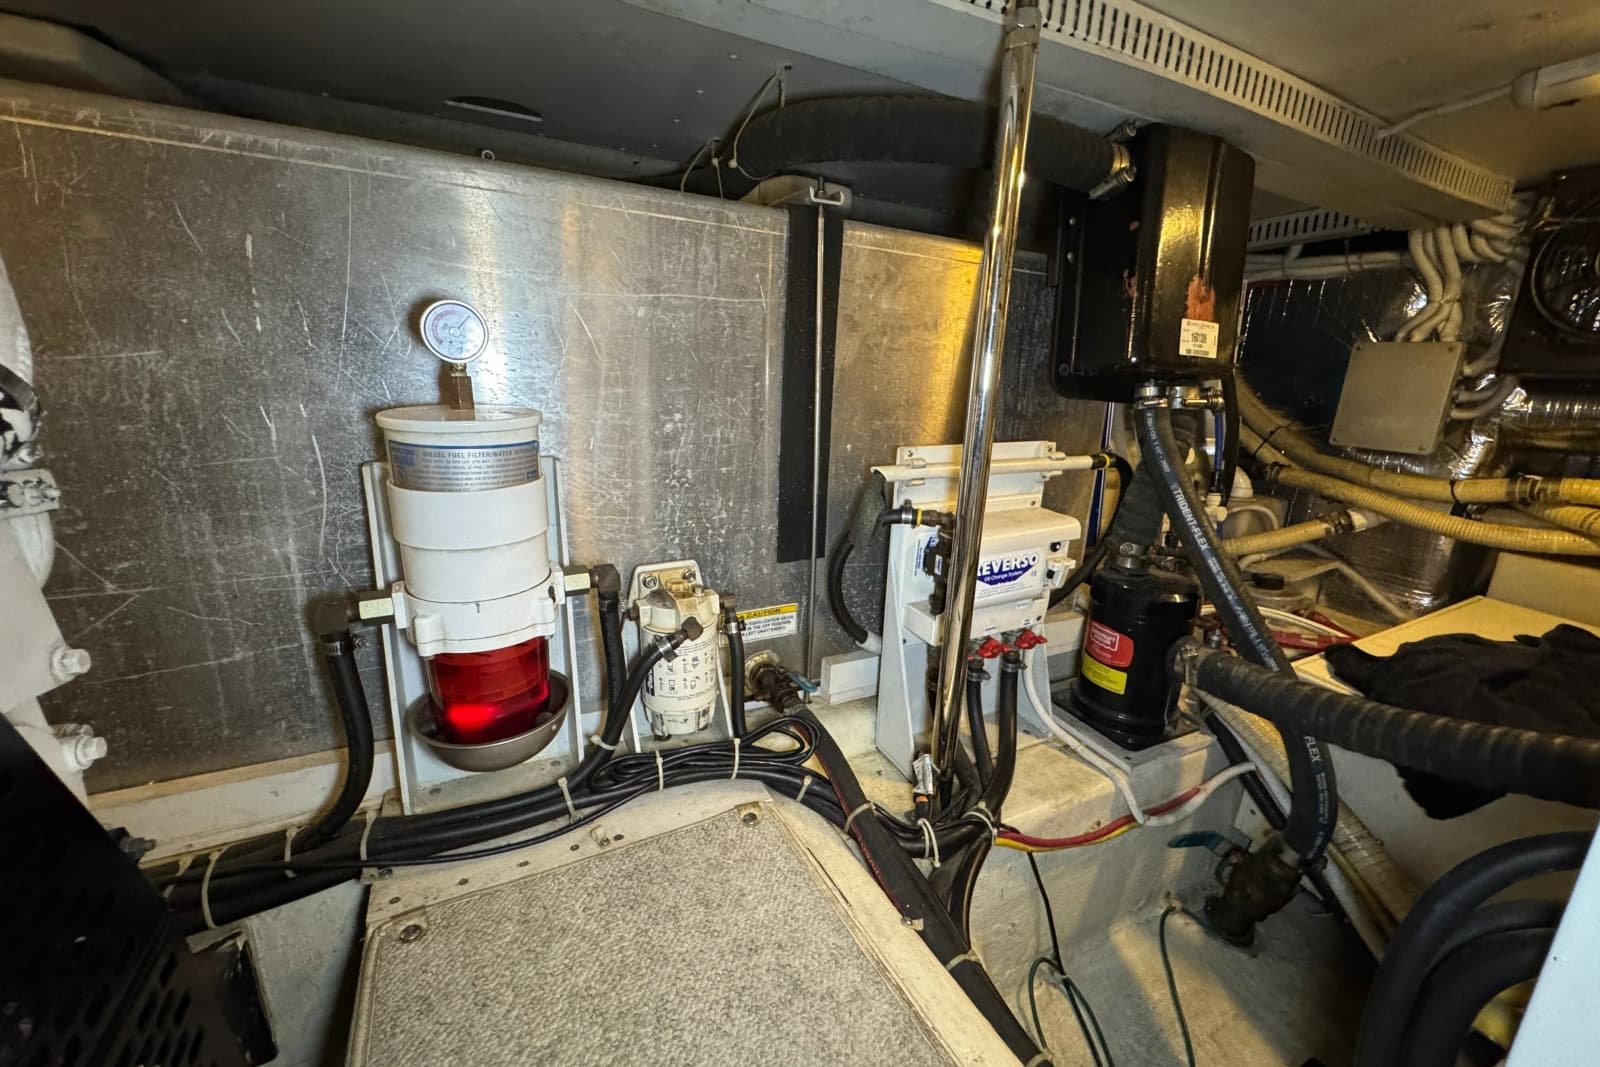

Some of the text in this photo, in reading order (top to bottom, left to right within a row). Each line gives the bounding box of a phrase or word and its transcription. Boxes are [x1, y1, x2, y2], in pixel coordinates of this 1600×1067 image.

[422, 450, 446, 458] DIESEL
[448, 451, 466, 459] FUEL
[467, 450, 512, 458] FILTER/WATER
[991, 573, 1008, 581] Change
[746, 608, 781, 619] CAUTION
